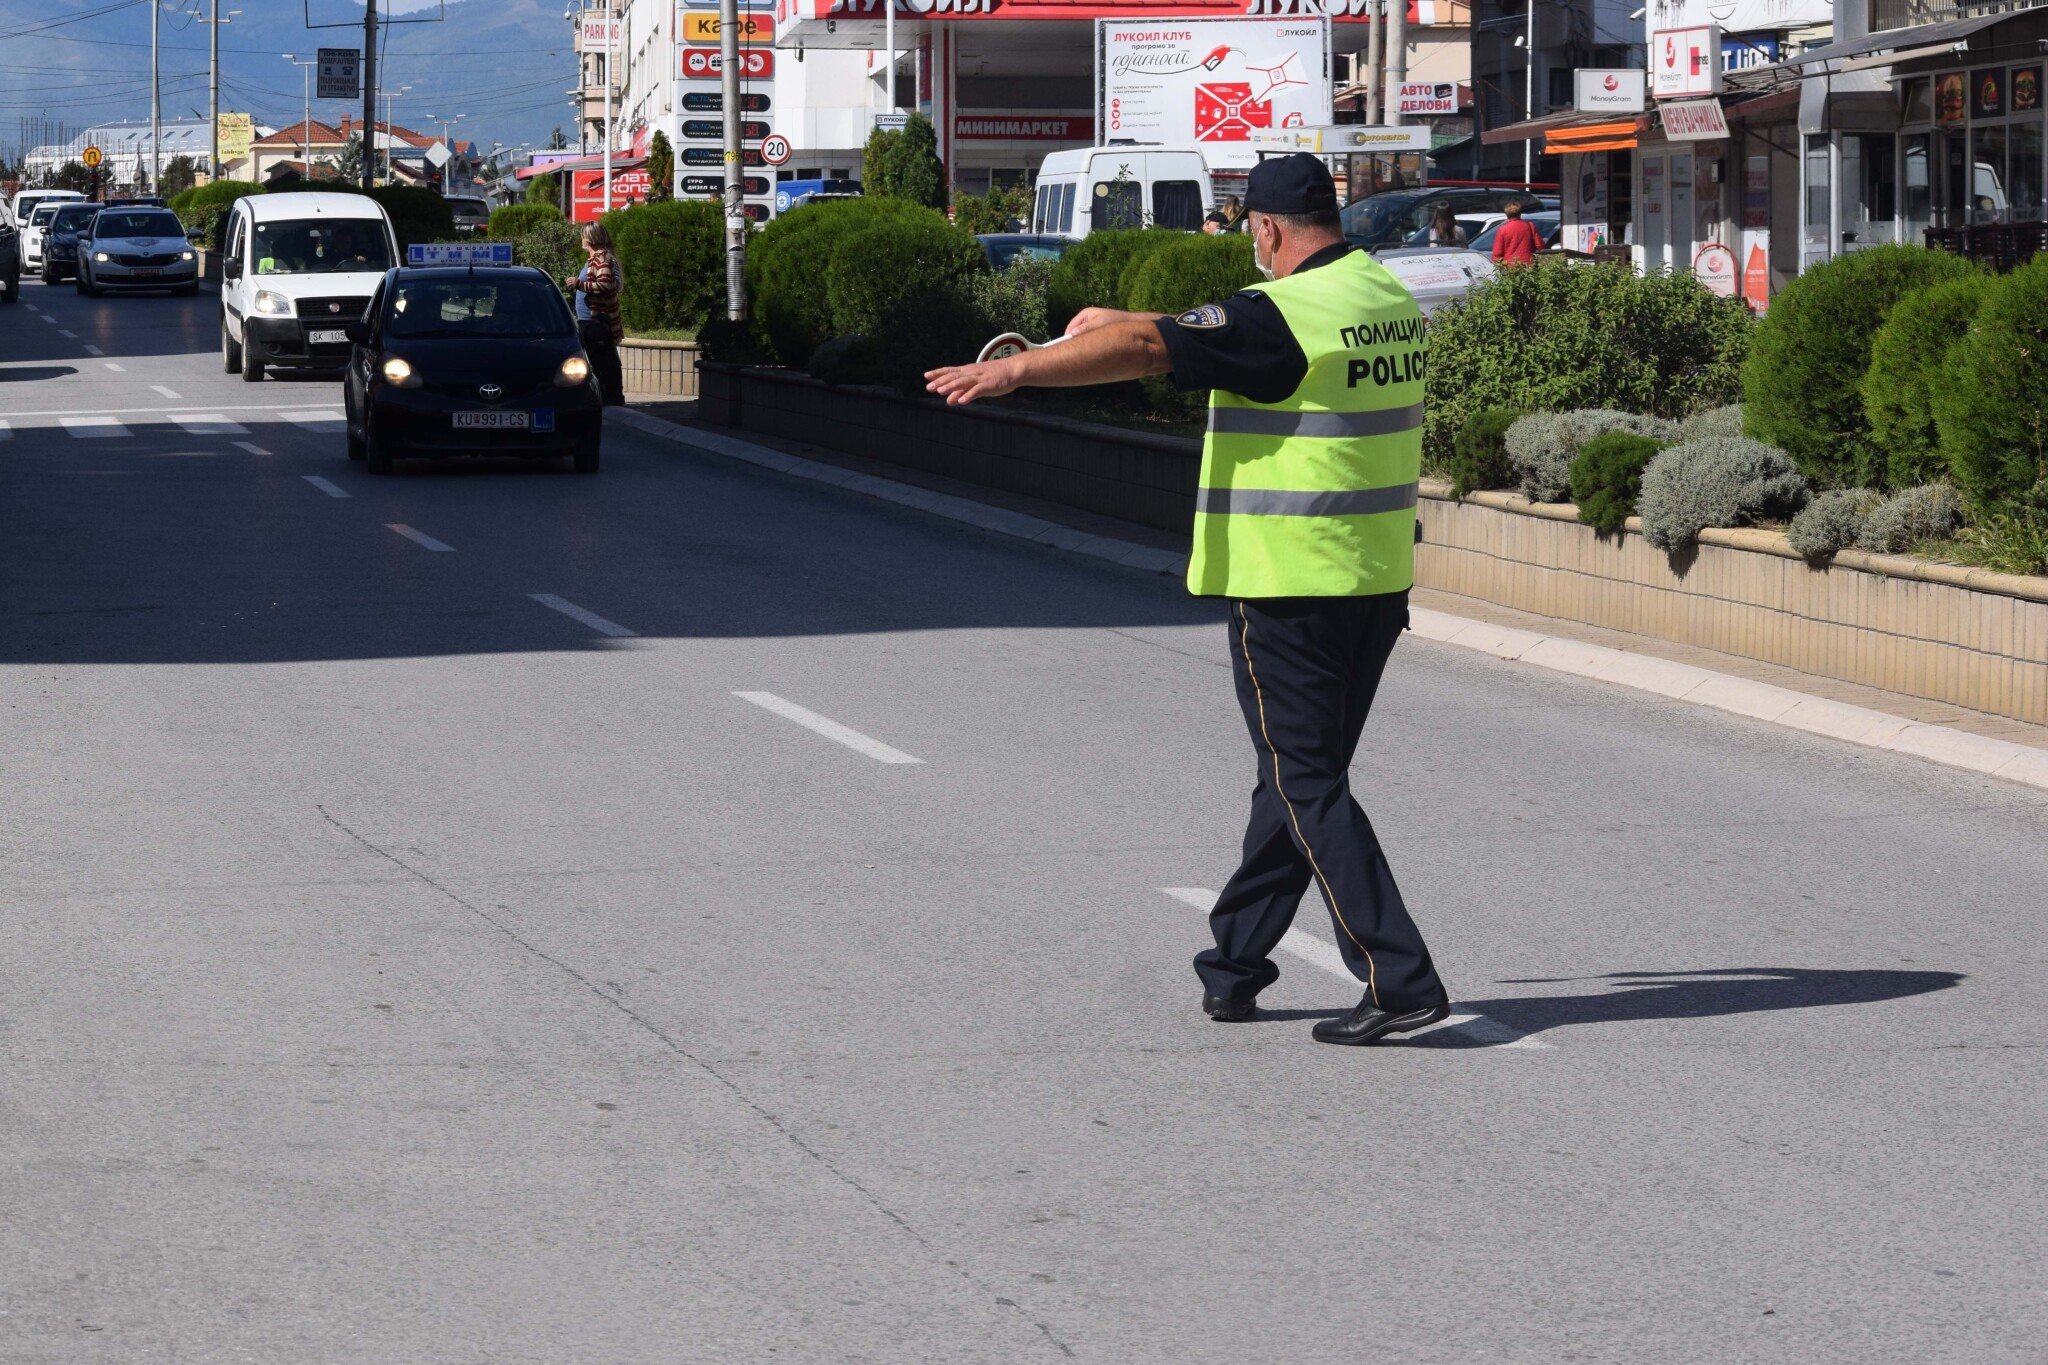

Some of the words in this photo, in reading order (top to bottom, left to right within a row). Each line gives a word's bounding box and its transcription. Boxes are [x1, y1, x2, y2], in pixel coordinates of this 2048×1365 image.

[585, 24, 619, 39] PARKNG
[698, 19, 757, 34] кае
[1114, 33, 1160, 42] ЛУКОИЛ
[1163, 32, 1192, 40] КЛУБ
[1401, 85, 1432, 95] АВТО
[1590, 95, 1632, 103] MoneyGram
[1401, 100, 1451, 112] ДЕЛОВИ
[957, 121, 1069, 135] МИНИМАРКЕТ
[767, 142, 785, 156] 20
[313, 332, 323, 341] SK
[457, 414, 473, 426] KU
